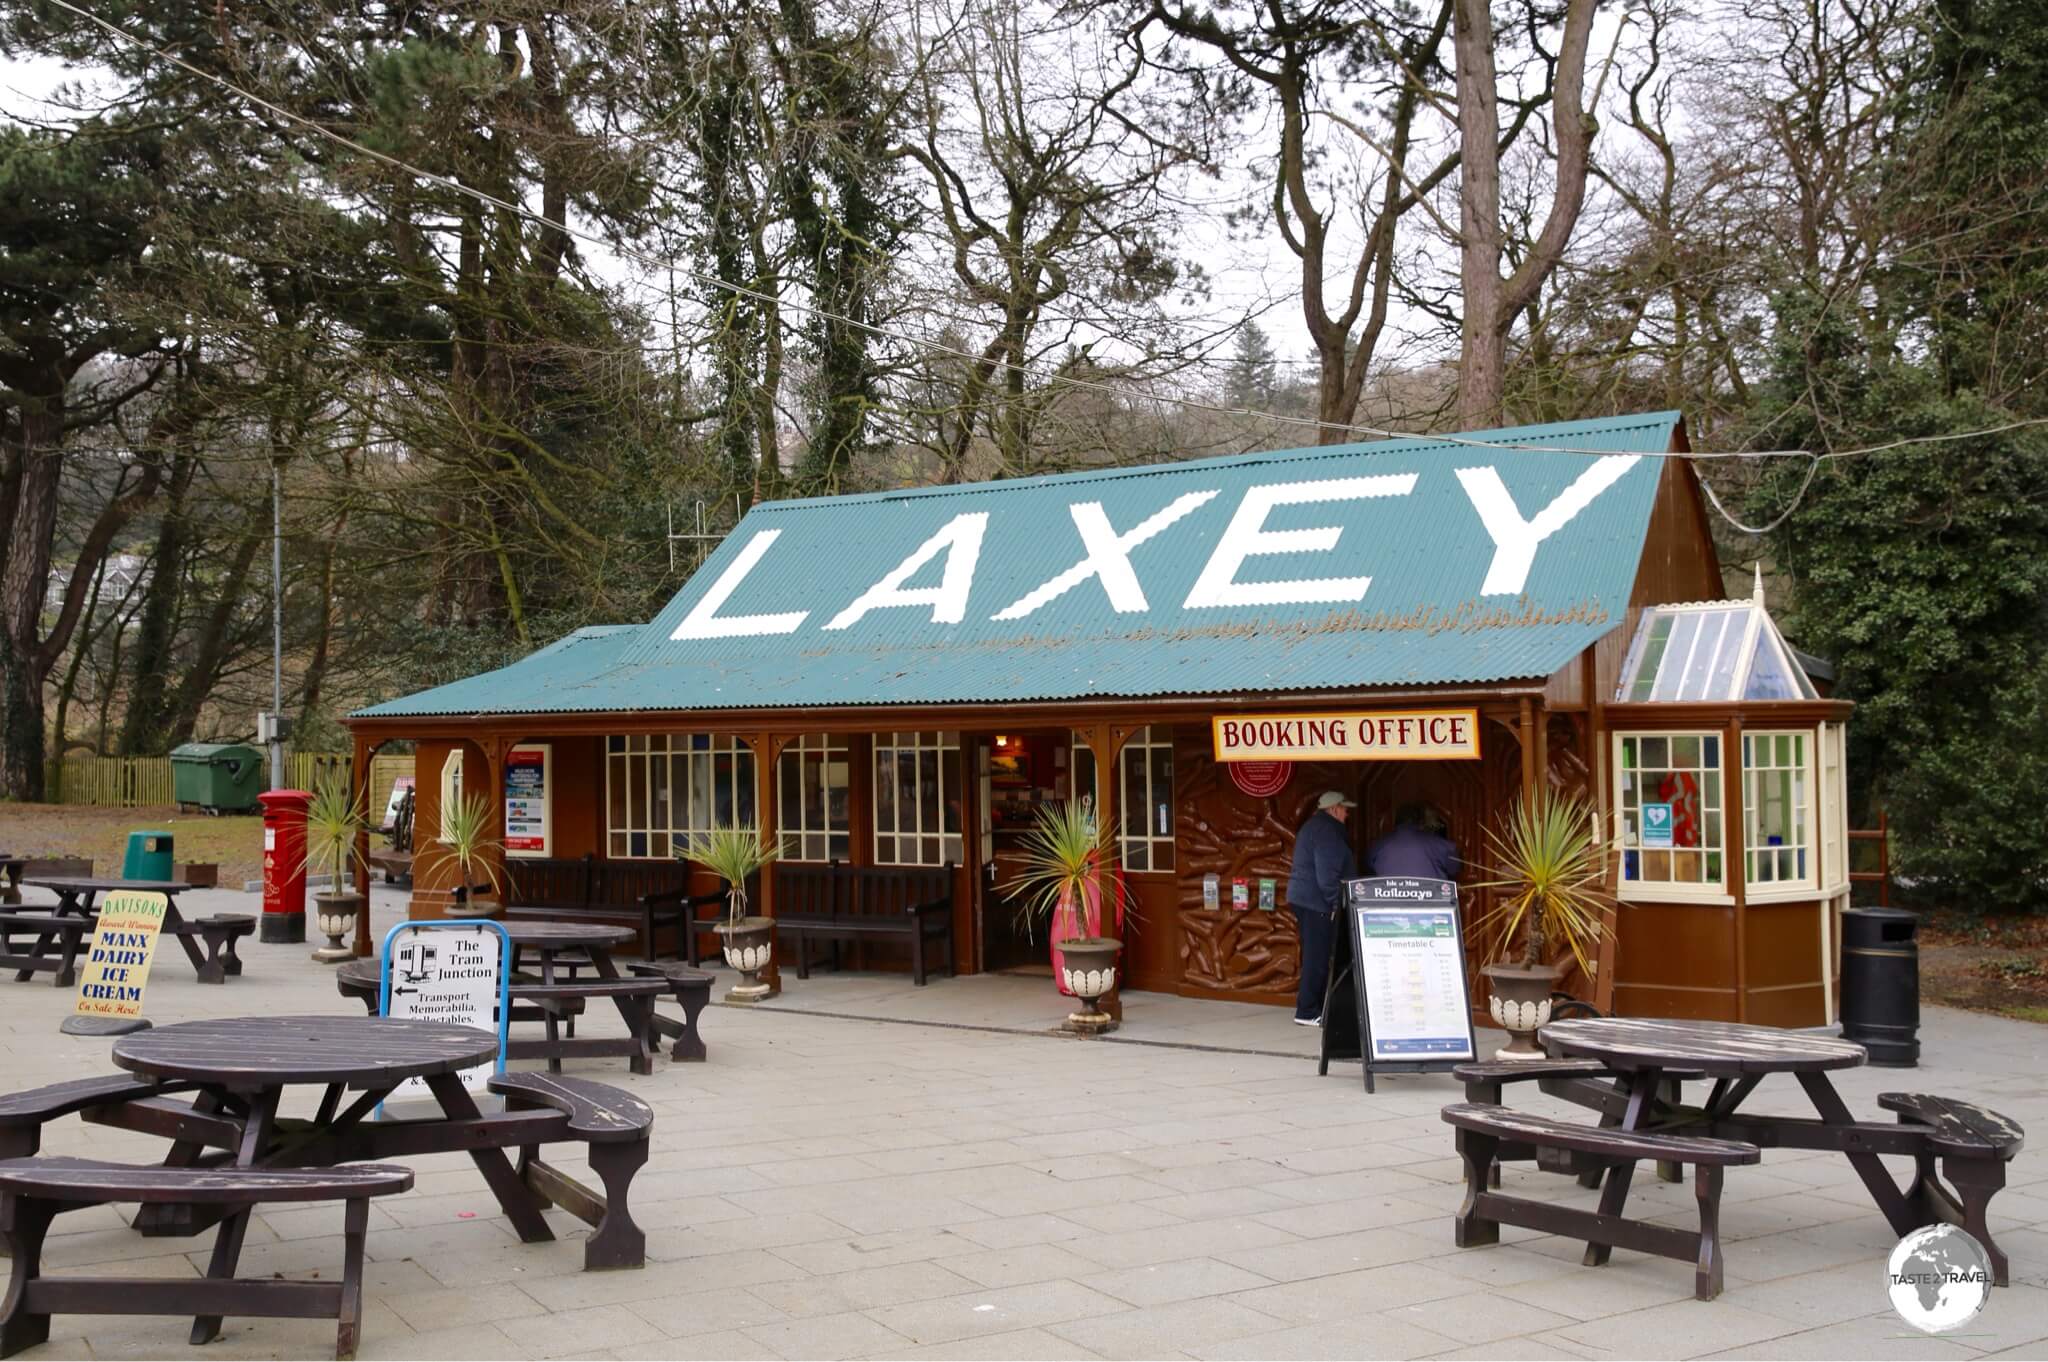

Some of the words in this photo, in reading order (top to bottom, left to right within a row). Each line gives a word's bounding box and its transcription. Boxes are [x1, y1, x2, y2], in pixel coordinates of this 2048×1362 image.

[670, 454, 1642, 641] LAXEY
[1223, 719, 1346, 747] BOOKING
[1358, 717, 1468, 745] OFFICE
[1374, 887, 1432, 900] Railways
[105, 899, 165, 918] DAVISONS
[99, 919, 125, 928] Award
[127, 920, 158, 931] Winning
[101, 932, 149, 948] MANX
[455, 940, 479, 952] The
[1388, 940, 1428, 949] Timetable
[1429, 939, 1434, 948] C
[91, 949, 149, 965] DAIRY
[449, 954, 483, 965] Tram
[101, 967, 129, 982] ICE
[439, 967, 492, 981] Junction
[82, 983, 141, 1001] CREAM
[418, 992, 470, 1003] Transport
[78, 1002, 91, 1011] On
[93, 1003, 112, 1013] Sale
[114, 1005, 140, 1015] Here!
[409, 1004, 477, 1014] Memorabilia,
